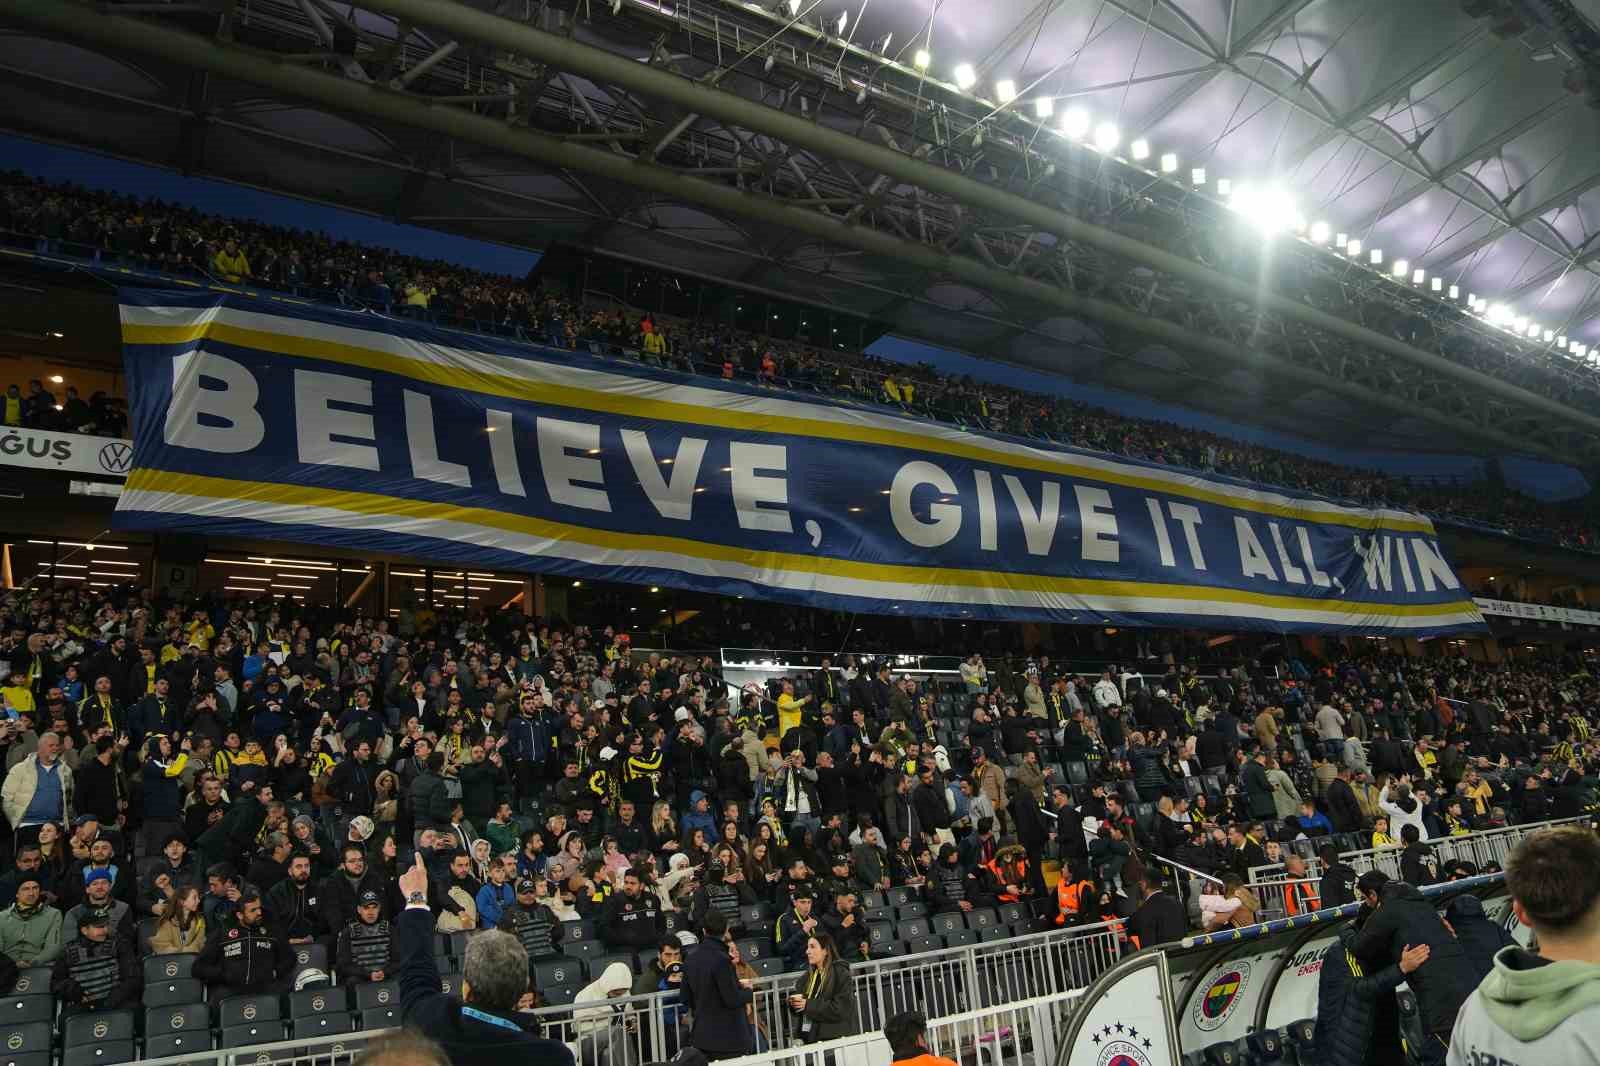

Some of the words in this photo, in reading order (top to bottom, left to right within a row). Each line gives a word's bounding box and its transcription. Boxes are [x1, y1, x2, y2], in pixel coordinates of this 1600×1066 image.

[164, 350, 823, 548] BELIEVE,
[889, 460, 1121, 564] GIVE
[1145, 497, 1208, 571] IT
[1232, 515, 1346, 595] ALL,
[1353, 533, 1461, 593] WIN
[1297, 960, 1323, 977] ENER
